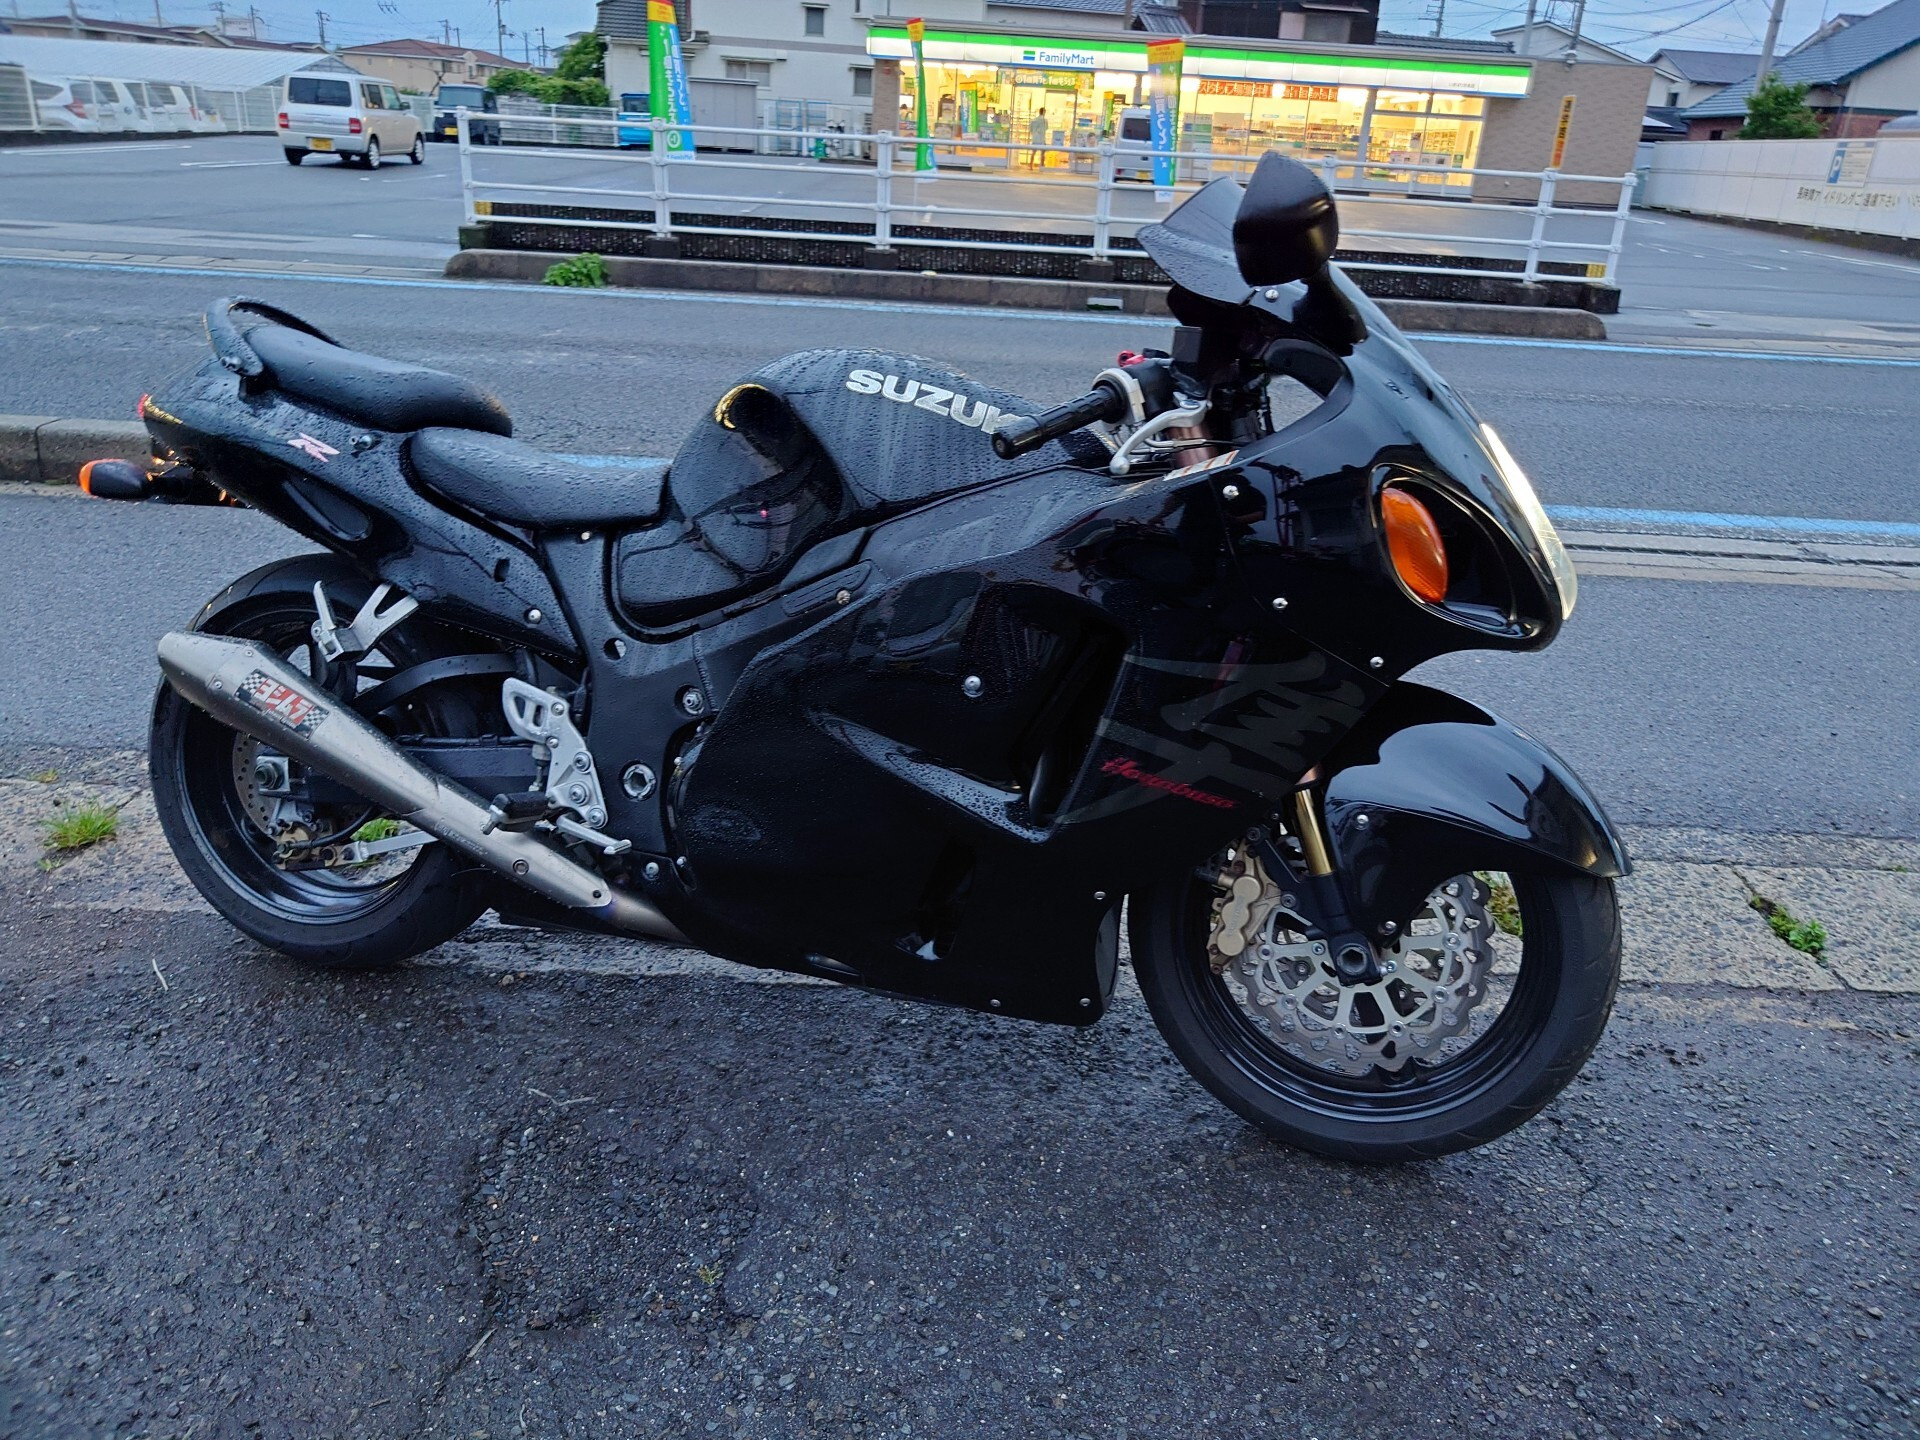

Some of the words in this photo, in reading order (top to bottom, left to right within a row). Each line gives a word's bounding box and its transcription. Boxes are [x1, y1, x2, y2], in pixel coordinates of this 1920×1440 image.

[1039, 51, 1094, 65] FamilyMart
[846, 369, 1022, 434] SUZUK
[253, 678, 315, 724] ヨシムラ
